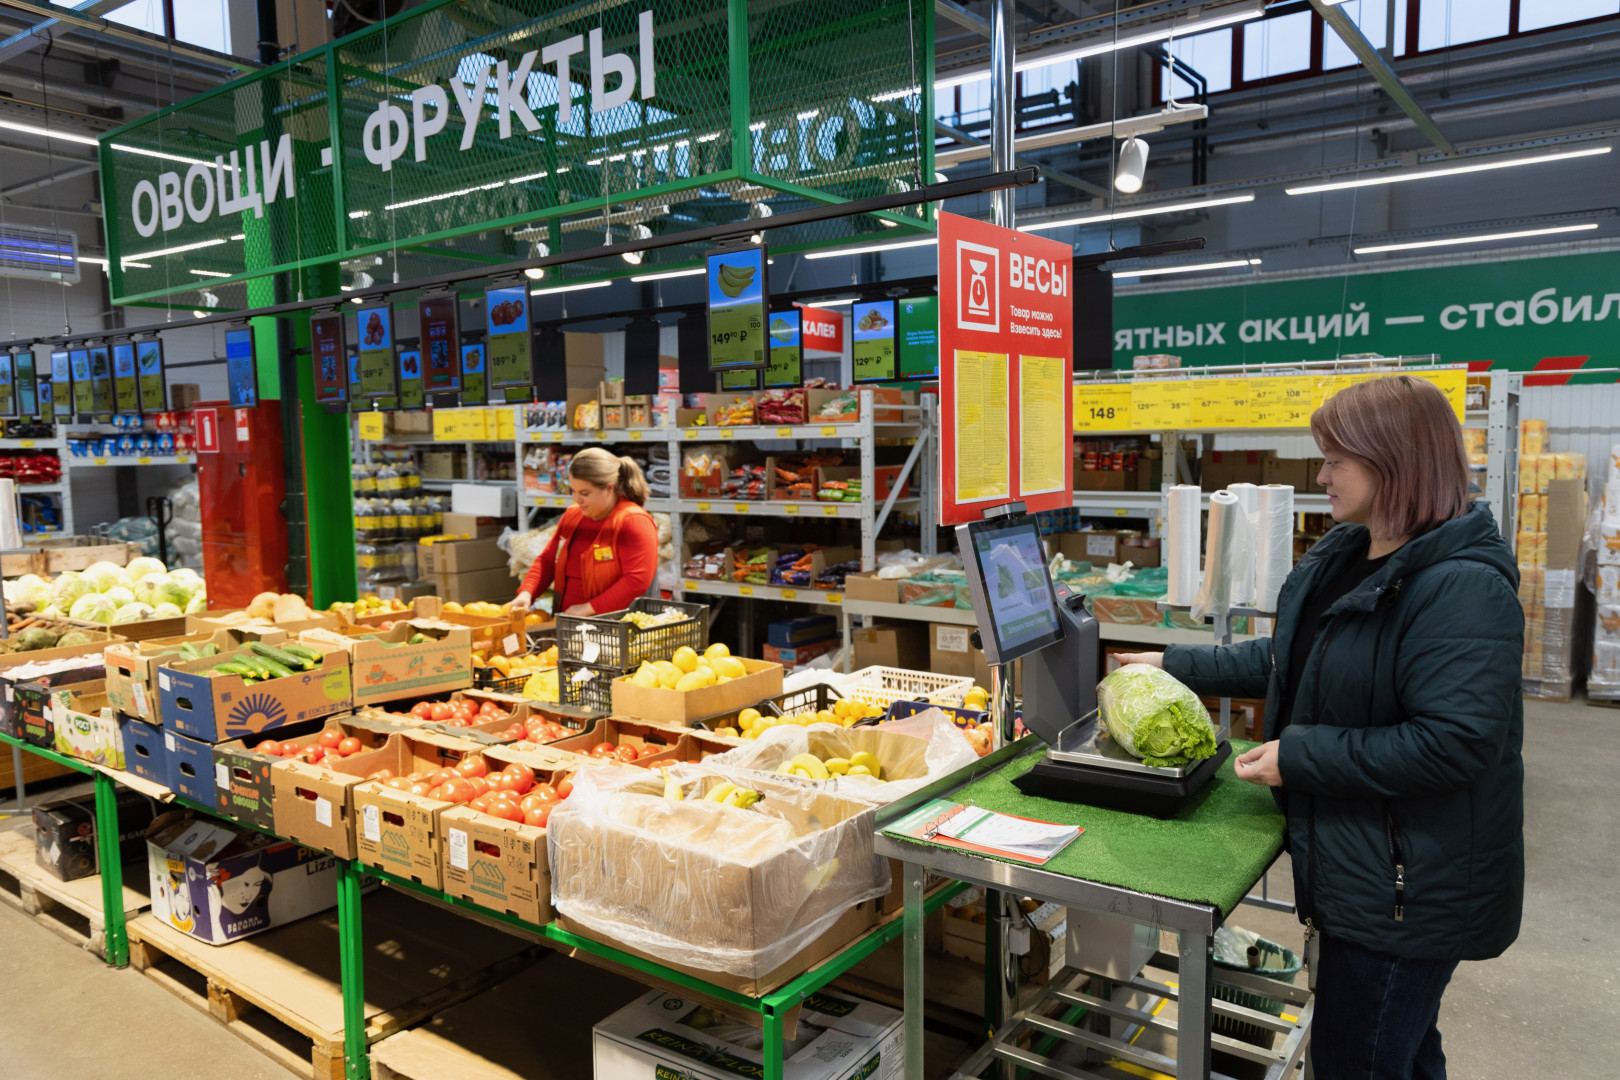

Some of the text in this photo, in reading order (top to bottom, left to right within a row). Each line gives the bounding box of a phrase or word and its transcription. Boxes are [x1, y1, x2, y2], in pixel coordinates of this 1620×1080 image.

[131, 132, 295, 238] ОВОЩИ
[362, 9, 656, 173] ФРУКТЫ
[1009, 251, 1067, 297] ВЕСЫ
[1010, 305, 1054, 322] Товар можно
[1238, 302, 1370, 345] акций
[1010, 322, 1063, 339] Взвесить здесь!
[1089, 407, 1115, 419] 148
